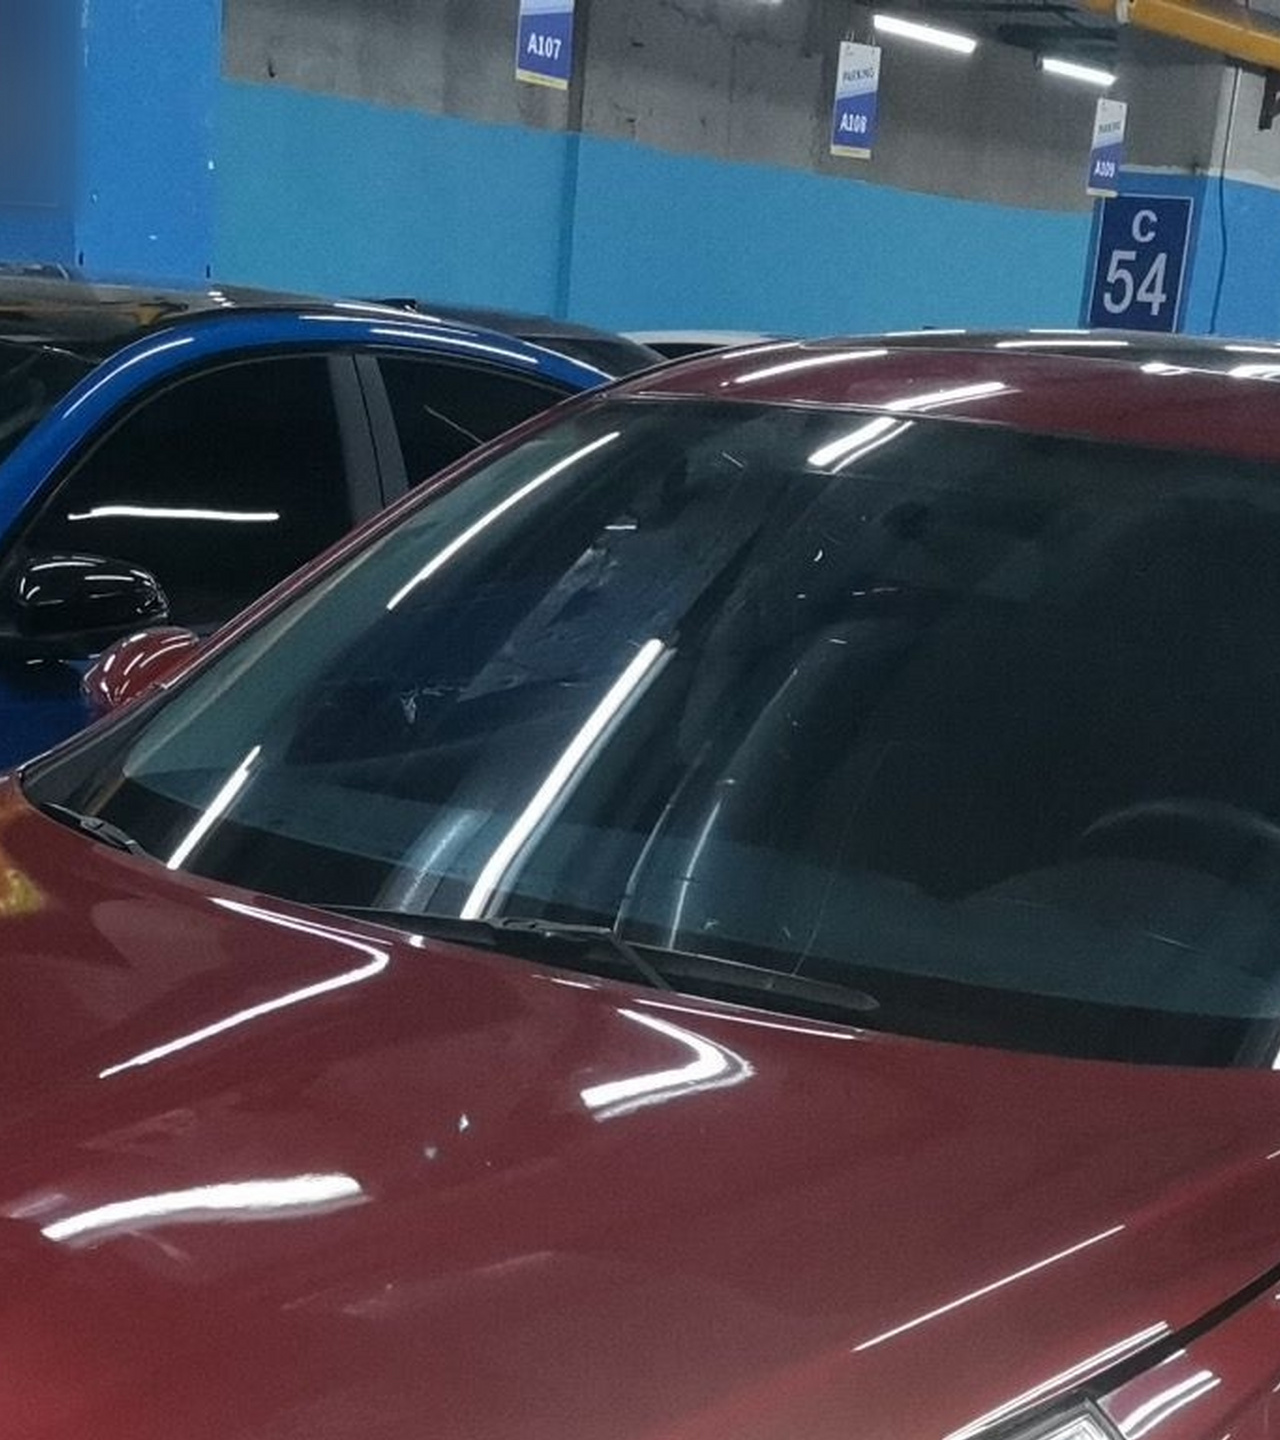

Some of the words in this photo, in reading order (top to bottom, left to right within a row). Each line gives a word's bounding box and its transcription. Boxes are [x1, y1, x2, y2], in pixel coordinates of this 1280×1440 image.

[527, 32, 562, 60] A107
[1132, 209, 1158, 243] C
[1103, 249, 1168, 316] 54
